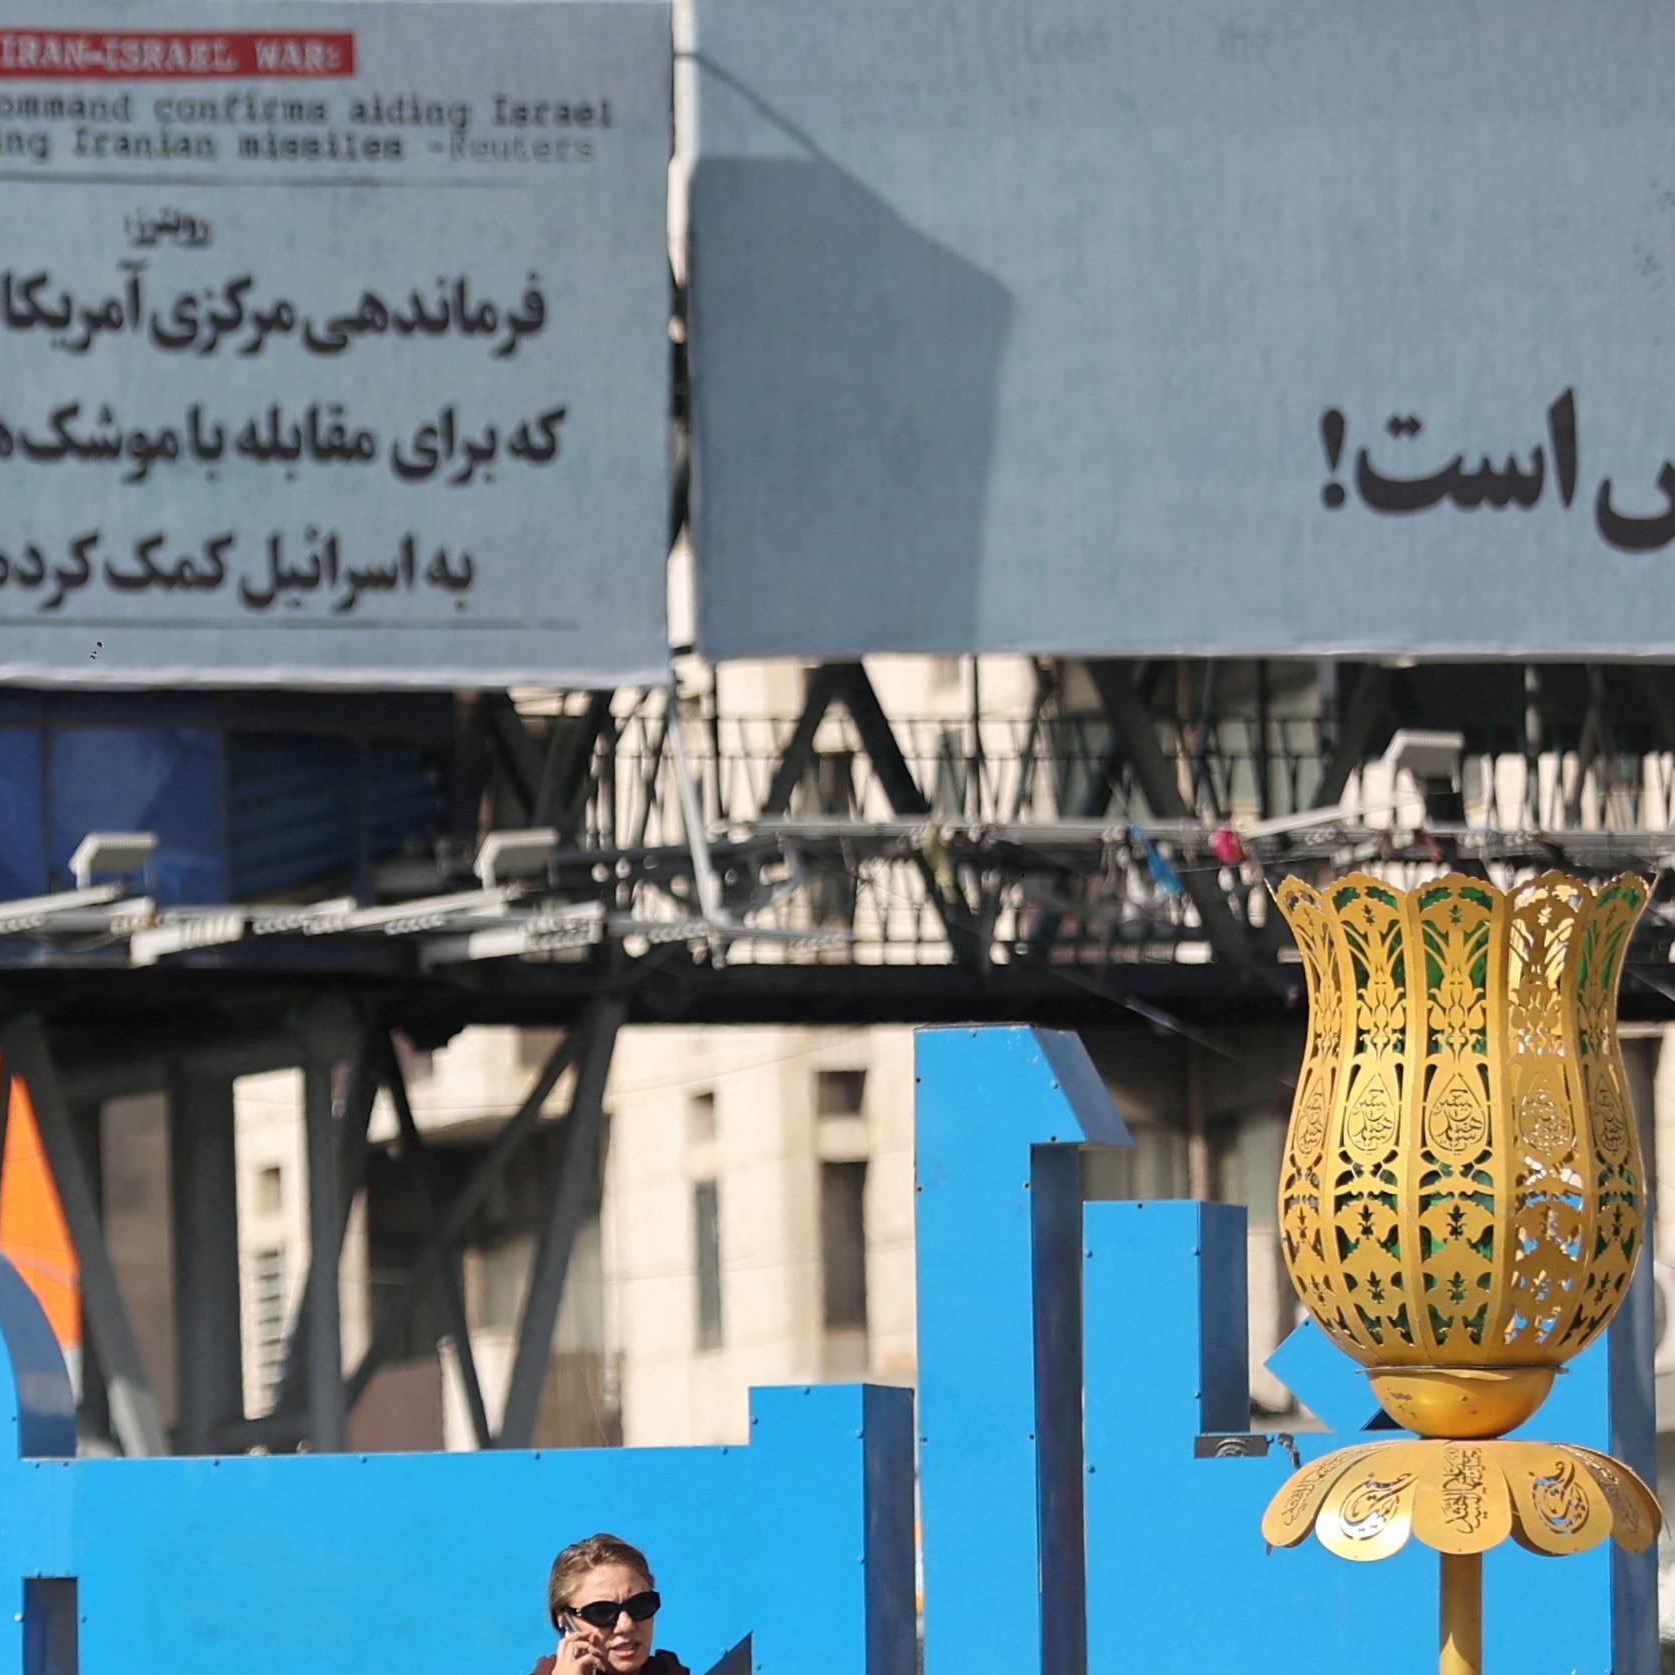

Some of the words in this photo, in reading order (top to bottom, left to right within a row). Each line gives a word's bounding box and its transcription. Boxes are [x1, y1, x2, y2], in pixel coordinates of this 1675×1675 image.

[0, 35, 238, 72] IRAN-ISRAEL
[73, 127, 217, 160] Iranian
[238, 127, 405, 162] missiles
[154, 92, 328, 127] confirms
[350, 93, 472, 134] aiding
[492, 93, 617, 129] Israel
[0, 257, 147, 356] آمریکا
[149, 273, 297, 357] مرکزی
[301, 268, 549, 359] فرماندهی
[187, 402, 227, 481] با
[235, 402, 377, 481] مقابله
[390, 404, 499, 486] برای
[506, 405, 568, 466] که
[103, 532, 237, 594] کمک
[237, 525, 417, 614] اسرائیل
[425, 548, 477, 613] به
